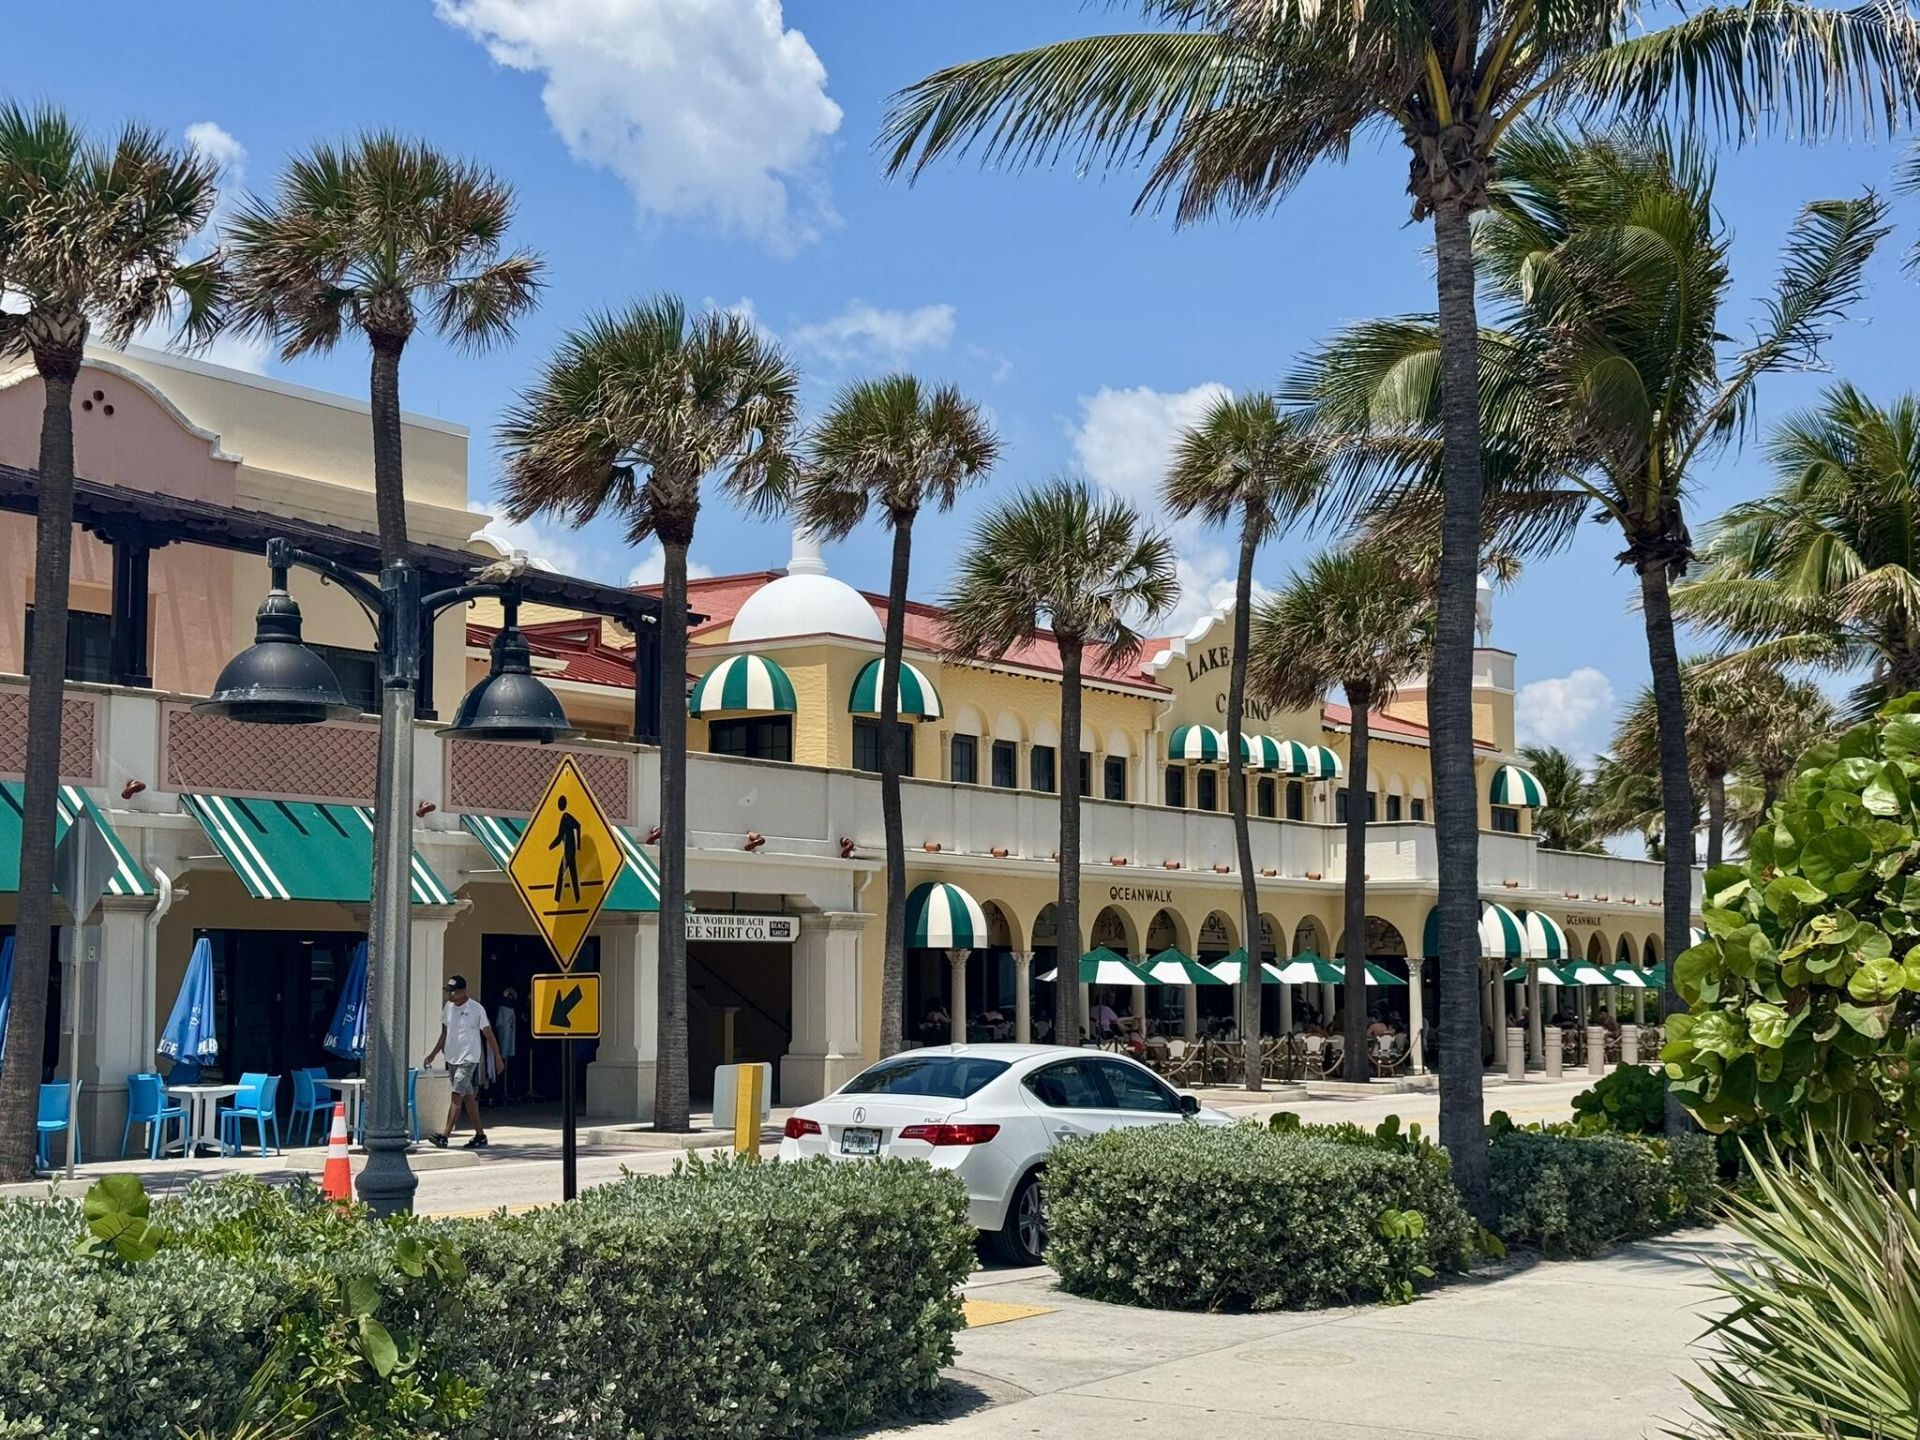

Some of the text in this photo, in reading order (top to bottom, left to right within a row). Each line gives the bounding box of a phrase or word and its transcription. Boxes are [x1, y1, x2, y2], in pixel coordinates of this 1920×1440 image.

[1186, 646, 1230, 683] LAKE
[1215, 692, 1271, 722] CINO
[1109, 886, 1173, 903] OCEANWALK
[685, 916, 764, 927] AKE WORTH BEACH
[1567, 915, 1601, 925] OCEANWALK
[686, 925, 766, 940] EE SHIRT CO.
